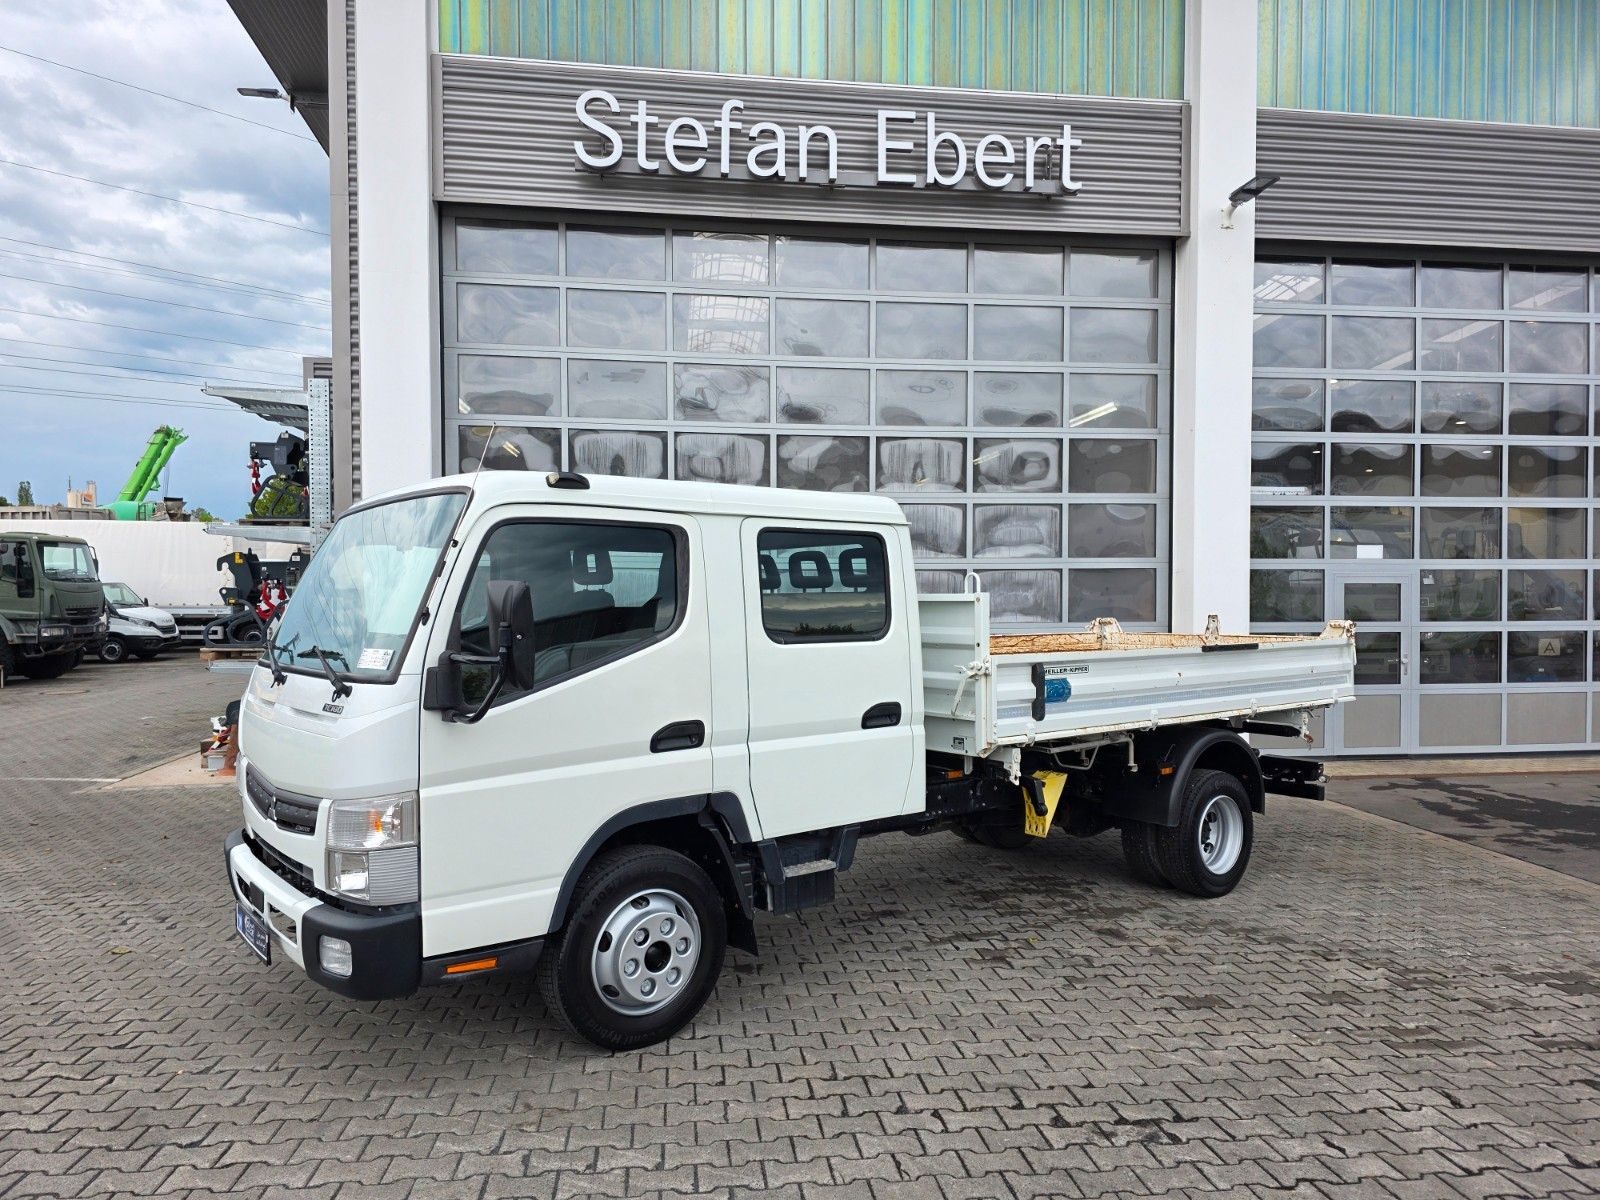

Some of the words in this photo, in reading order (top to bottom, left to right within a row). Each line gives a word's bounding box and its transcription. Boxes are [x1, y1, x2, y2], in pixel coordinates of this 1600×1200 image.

[573, 89, 838, 184] Stefan
[877, 109, 1083, 196] Ebert
[1543, 641, 1556, 654] A
